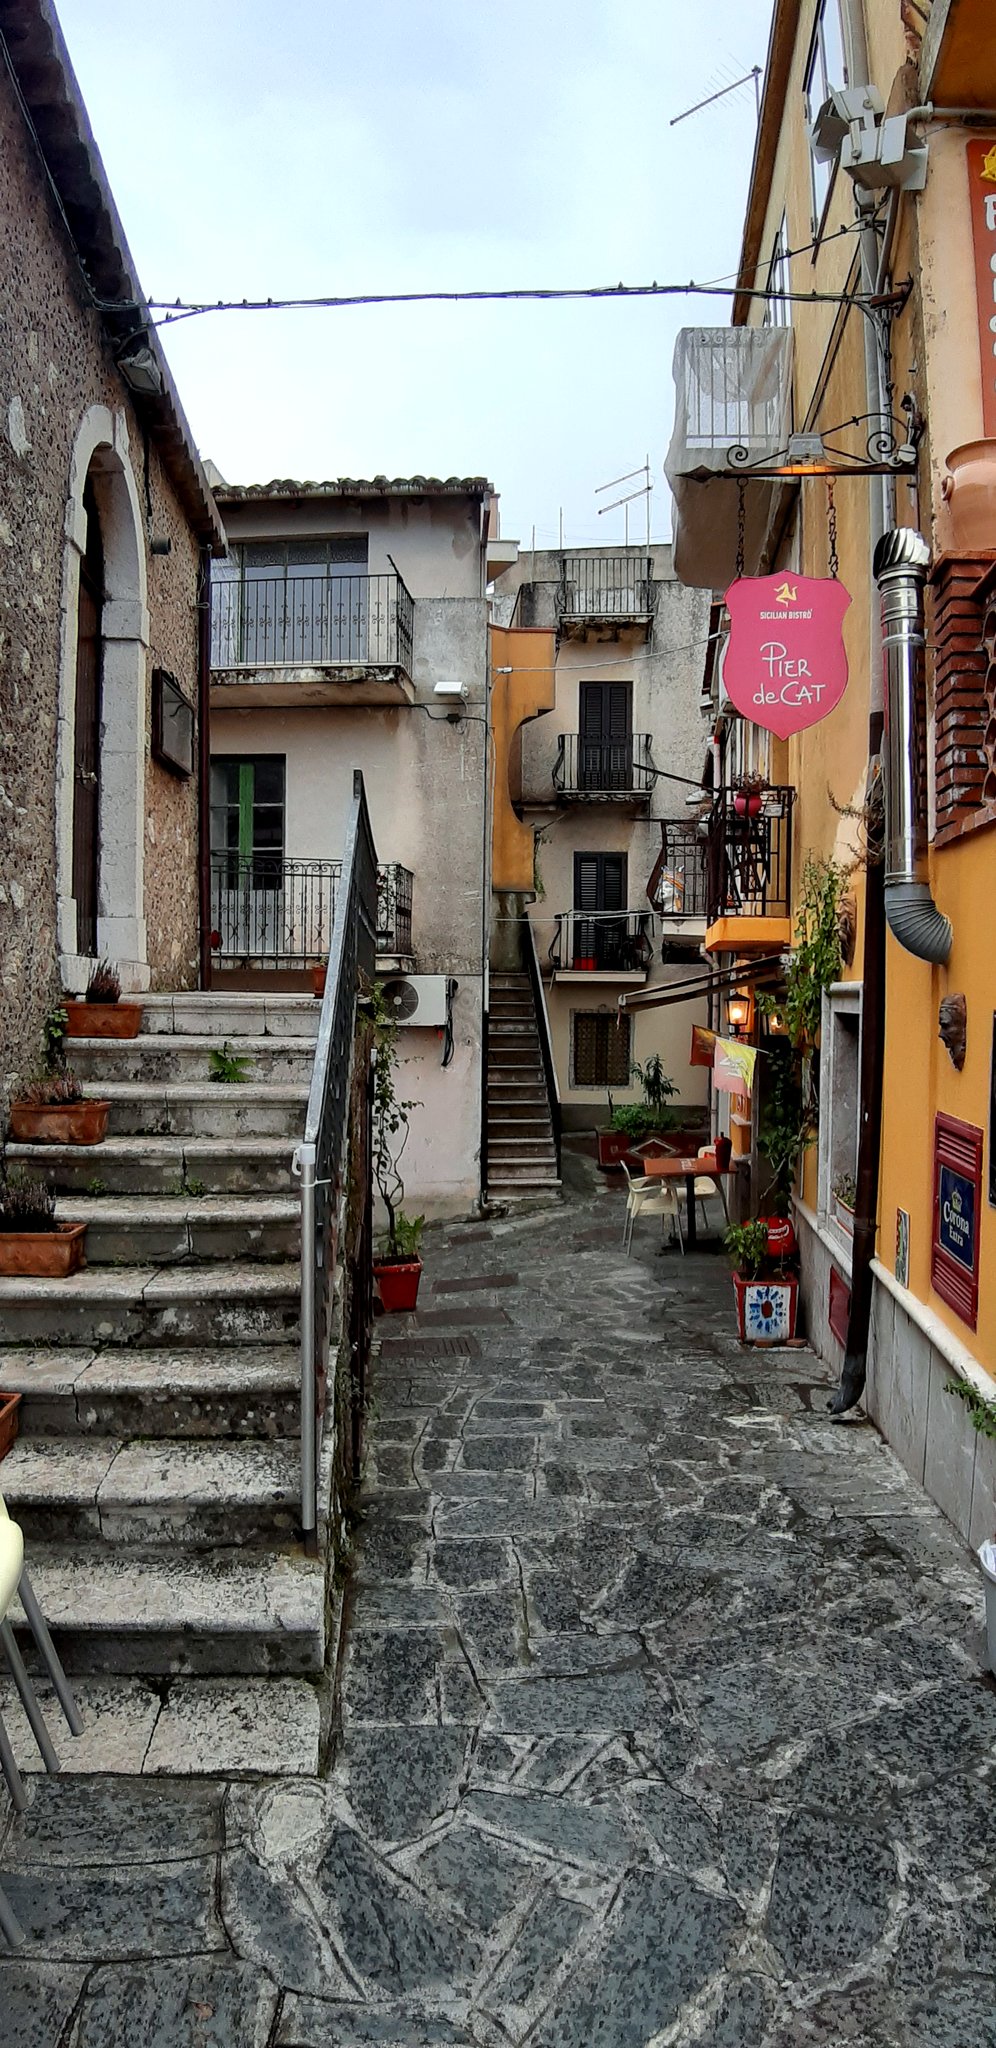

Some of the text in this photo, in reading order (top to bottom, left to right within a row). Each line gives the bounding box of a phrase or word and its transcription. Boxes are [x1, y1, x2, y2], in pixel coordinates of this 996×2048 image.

[760, 611, 787, 620] SICILIAN
[760, 641, 812, 678] PIER
[943, 1201, 970, 1236] Corona
[949, 1225, 963, 1247] Extra
